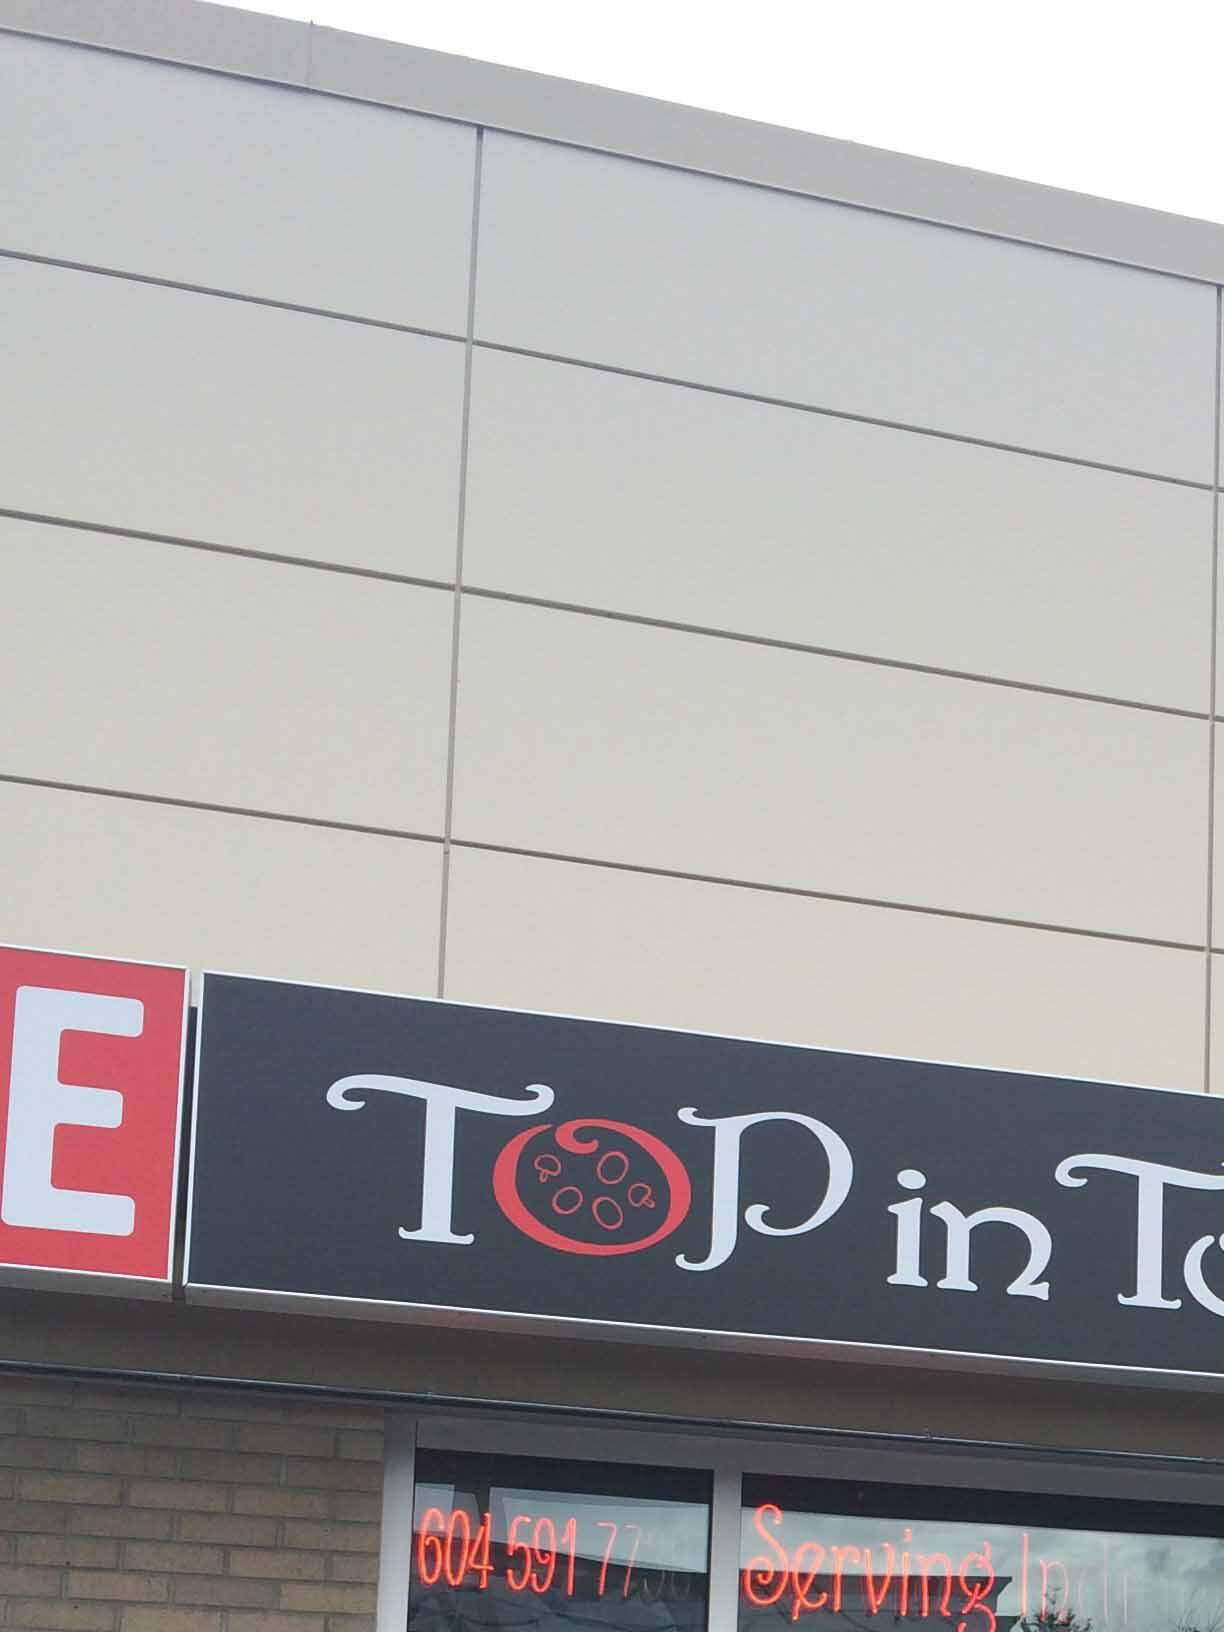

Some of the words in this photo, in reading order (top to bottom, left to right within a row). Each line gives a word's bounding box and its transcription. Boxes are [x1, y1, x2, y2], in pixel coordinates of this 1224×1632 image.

[1, 985, 144, 1237] E
[886, 1168, 1053, 1302] in
[416, 1506, 495, 1591] 604
[506, 1514, 578, 1596] 591
